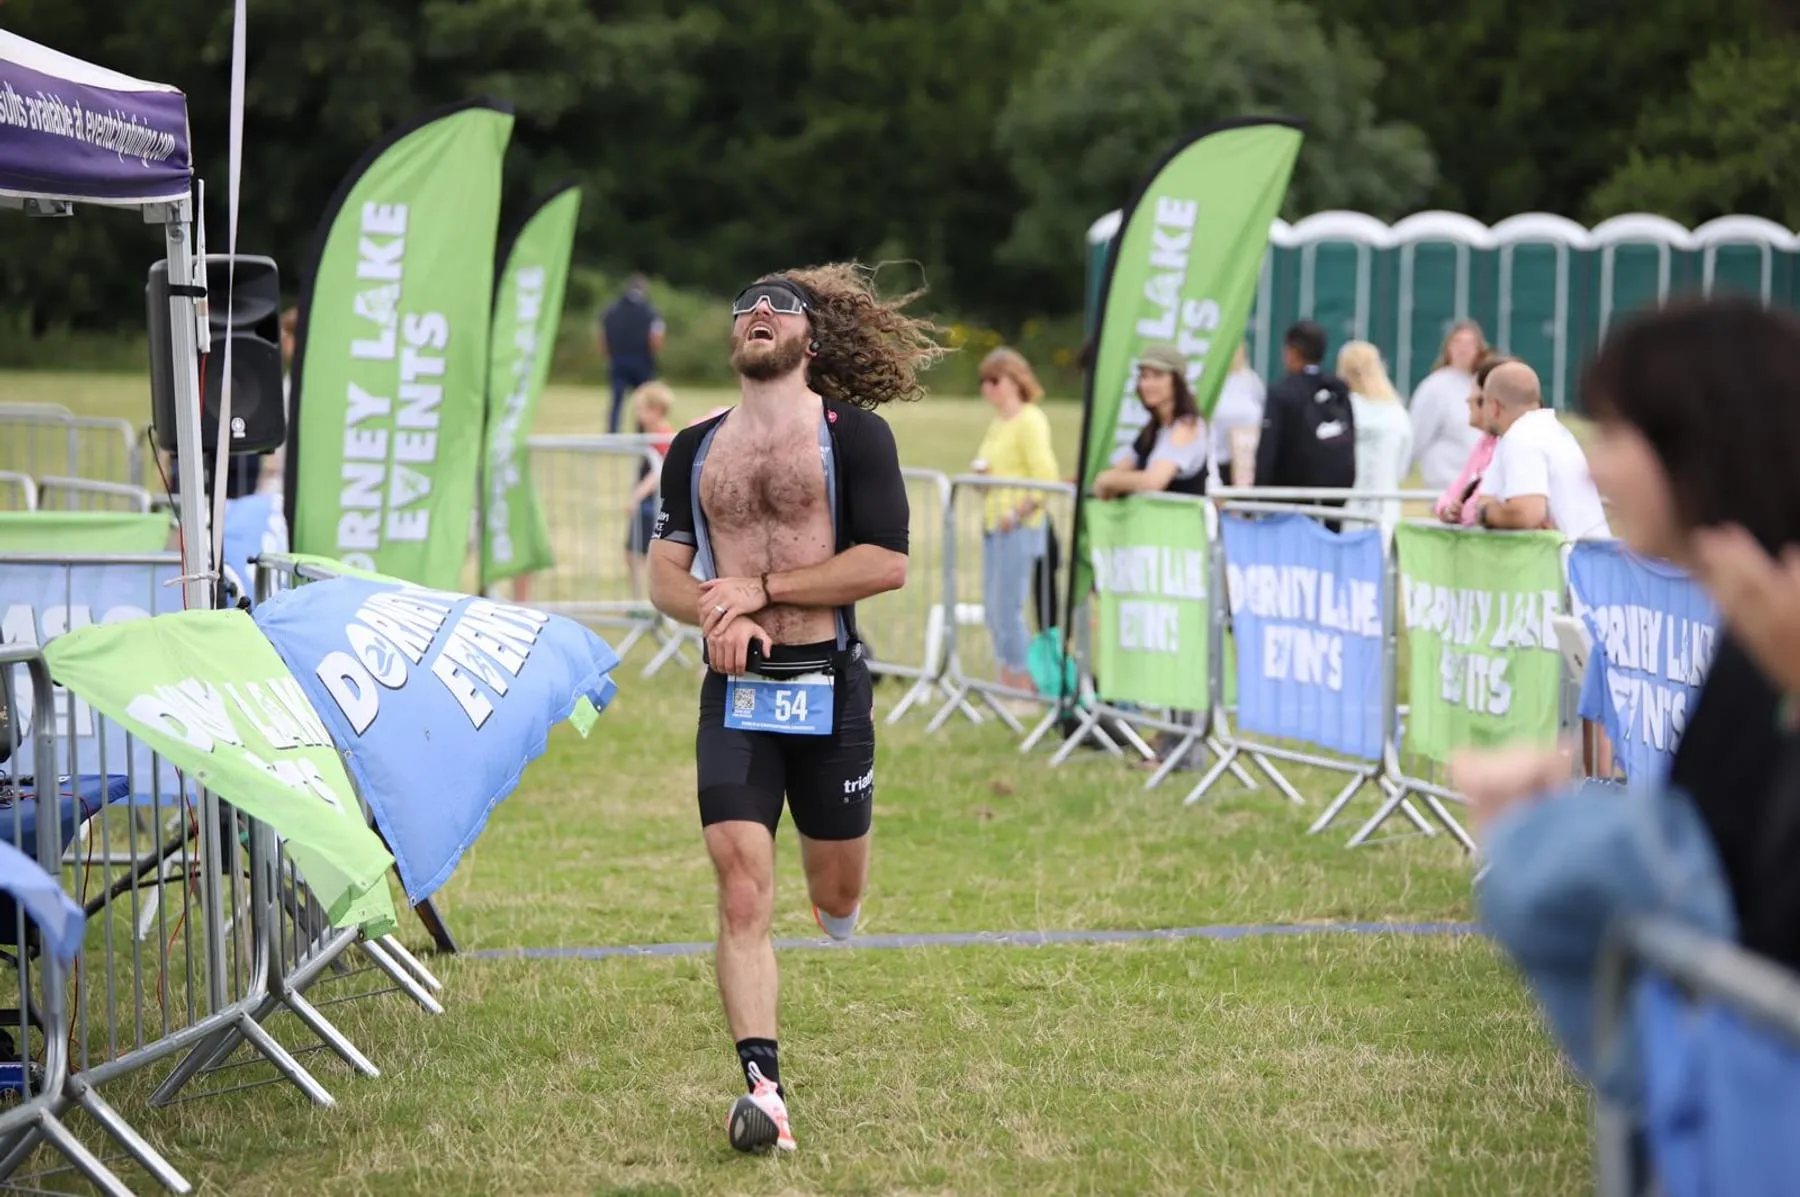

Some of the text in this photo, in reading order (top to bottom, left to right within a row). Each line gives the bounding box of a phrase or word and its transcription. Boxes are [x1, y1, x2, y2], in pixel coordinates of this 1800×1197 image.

[350, 201, 409, 360] LAKE
[1135, 195, 1199, 340] LAKE
[387, 311, 450, 542] EVENTS
[775, 690, 808, 721] 54
